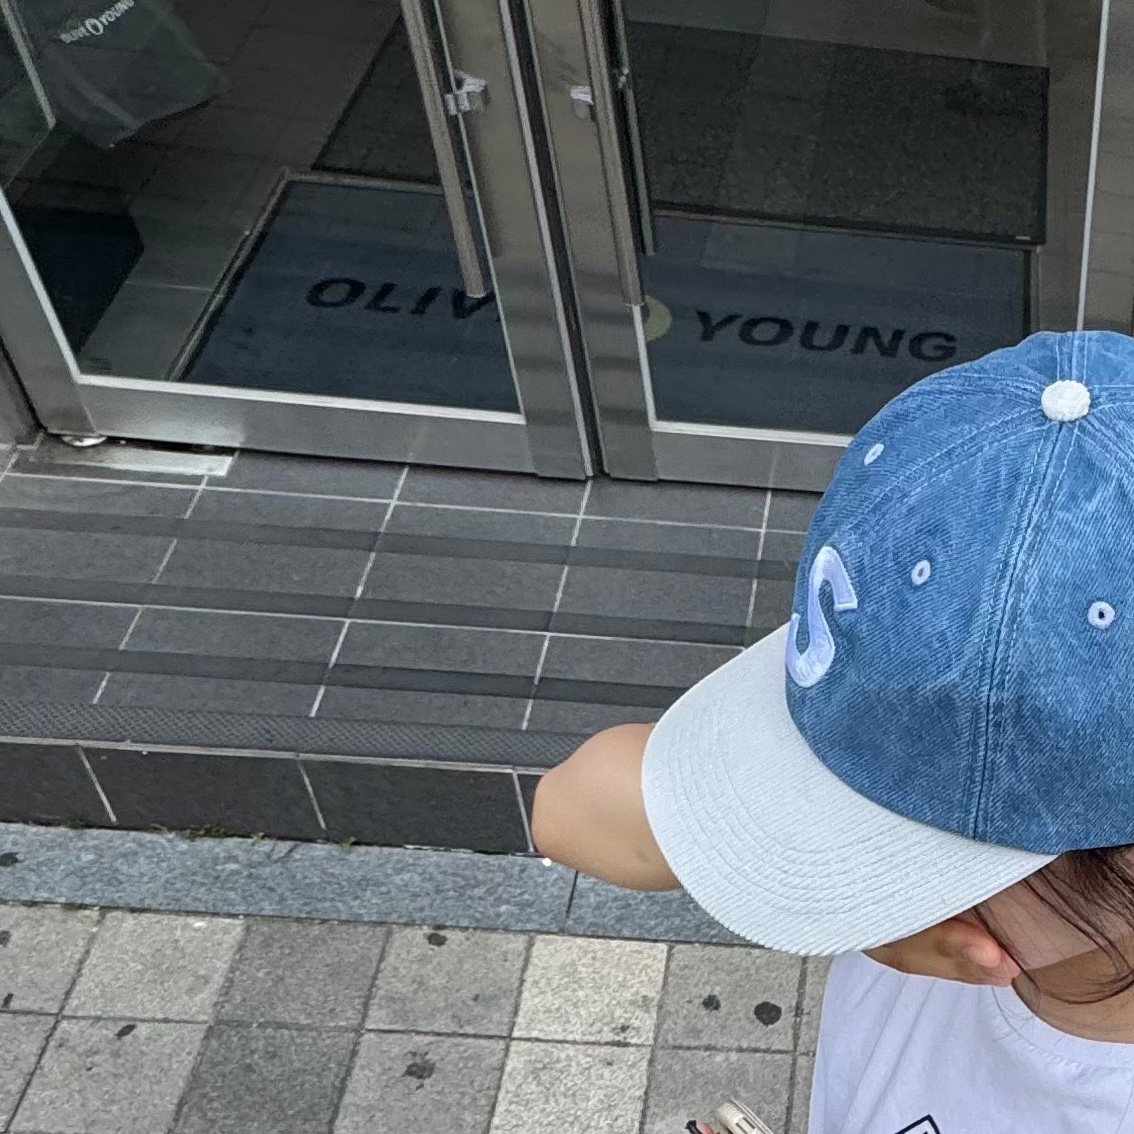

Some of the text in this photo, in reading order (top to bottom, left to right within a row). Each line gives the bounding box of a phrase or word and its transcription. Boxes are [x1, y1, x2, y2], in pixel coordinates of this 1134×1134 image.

[306, 277, 957, 362] OLIV YOUNG
[786, 546, 858, 688] S
